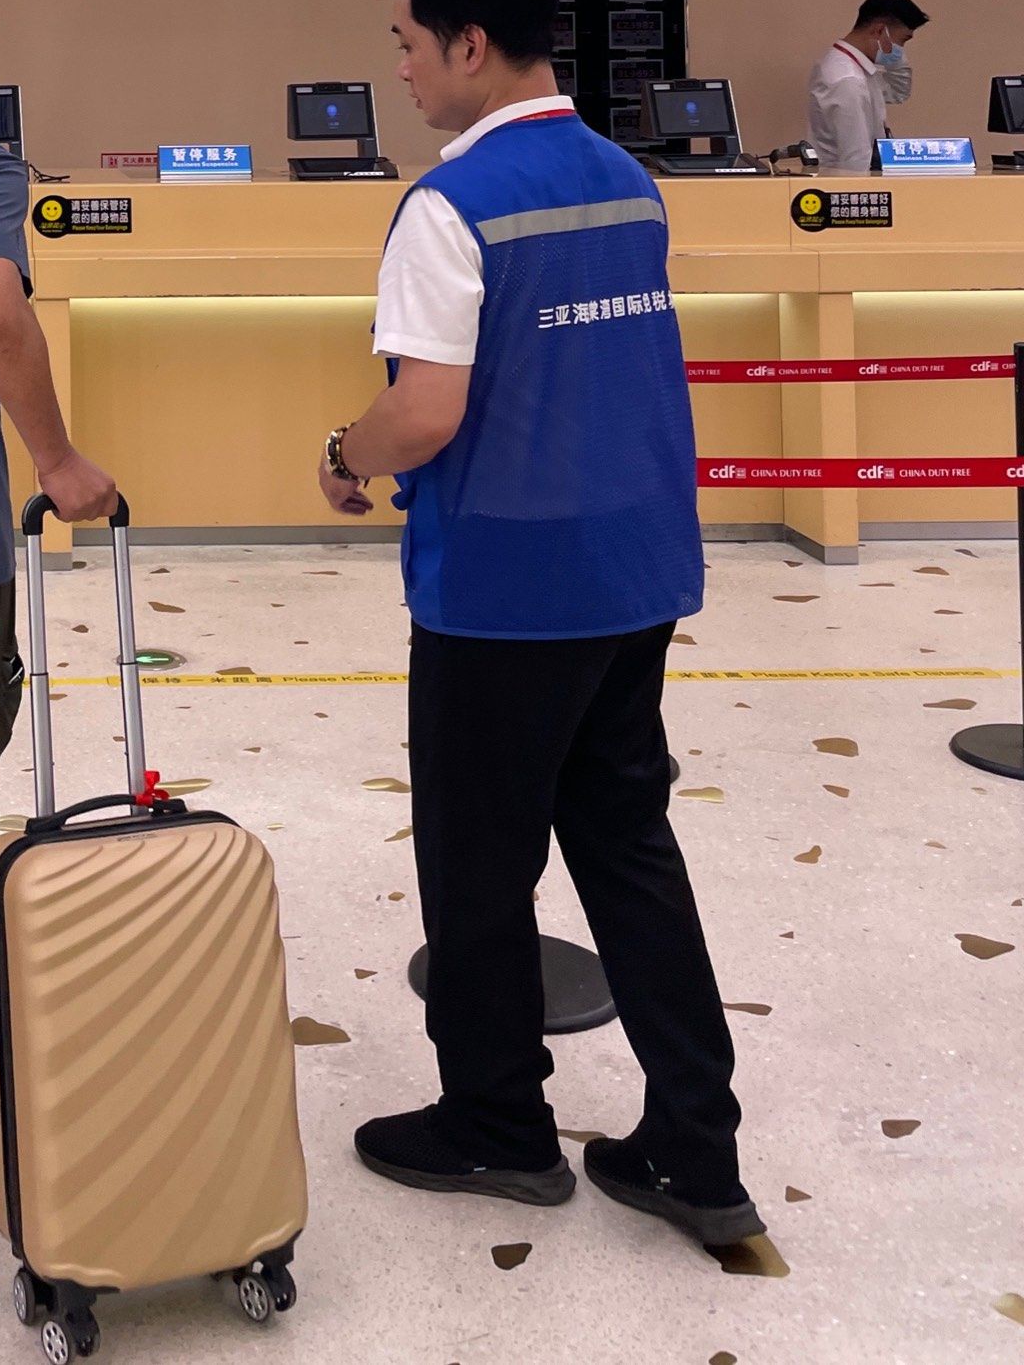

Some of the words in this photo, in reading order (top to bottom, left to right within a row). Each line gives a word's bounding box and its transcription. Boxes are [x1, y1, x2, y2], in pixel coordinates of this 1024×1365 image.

[172, 148, 238, 162] 暂停服务
[746, 366, 767, 377] cdf
[858, 364, 880, 375] cdf
[970, 361, 991, 372] cdf
[709, 465, 736, 479] cdf
[750, 469, 778, 478] CHINA
[779, 469, 802, 478] DUTY
[803, 469, 822, 477] FREE
[857, 465, 884, 479] cdf
[899, 469, 927, 477] CHINA
[928, 469, 951, 477] DUTY
[952, 468, 971, 477] FREE
